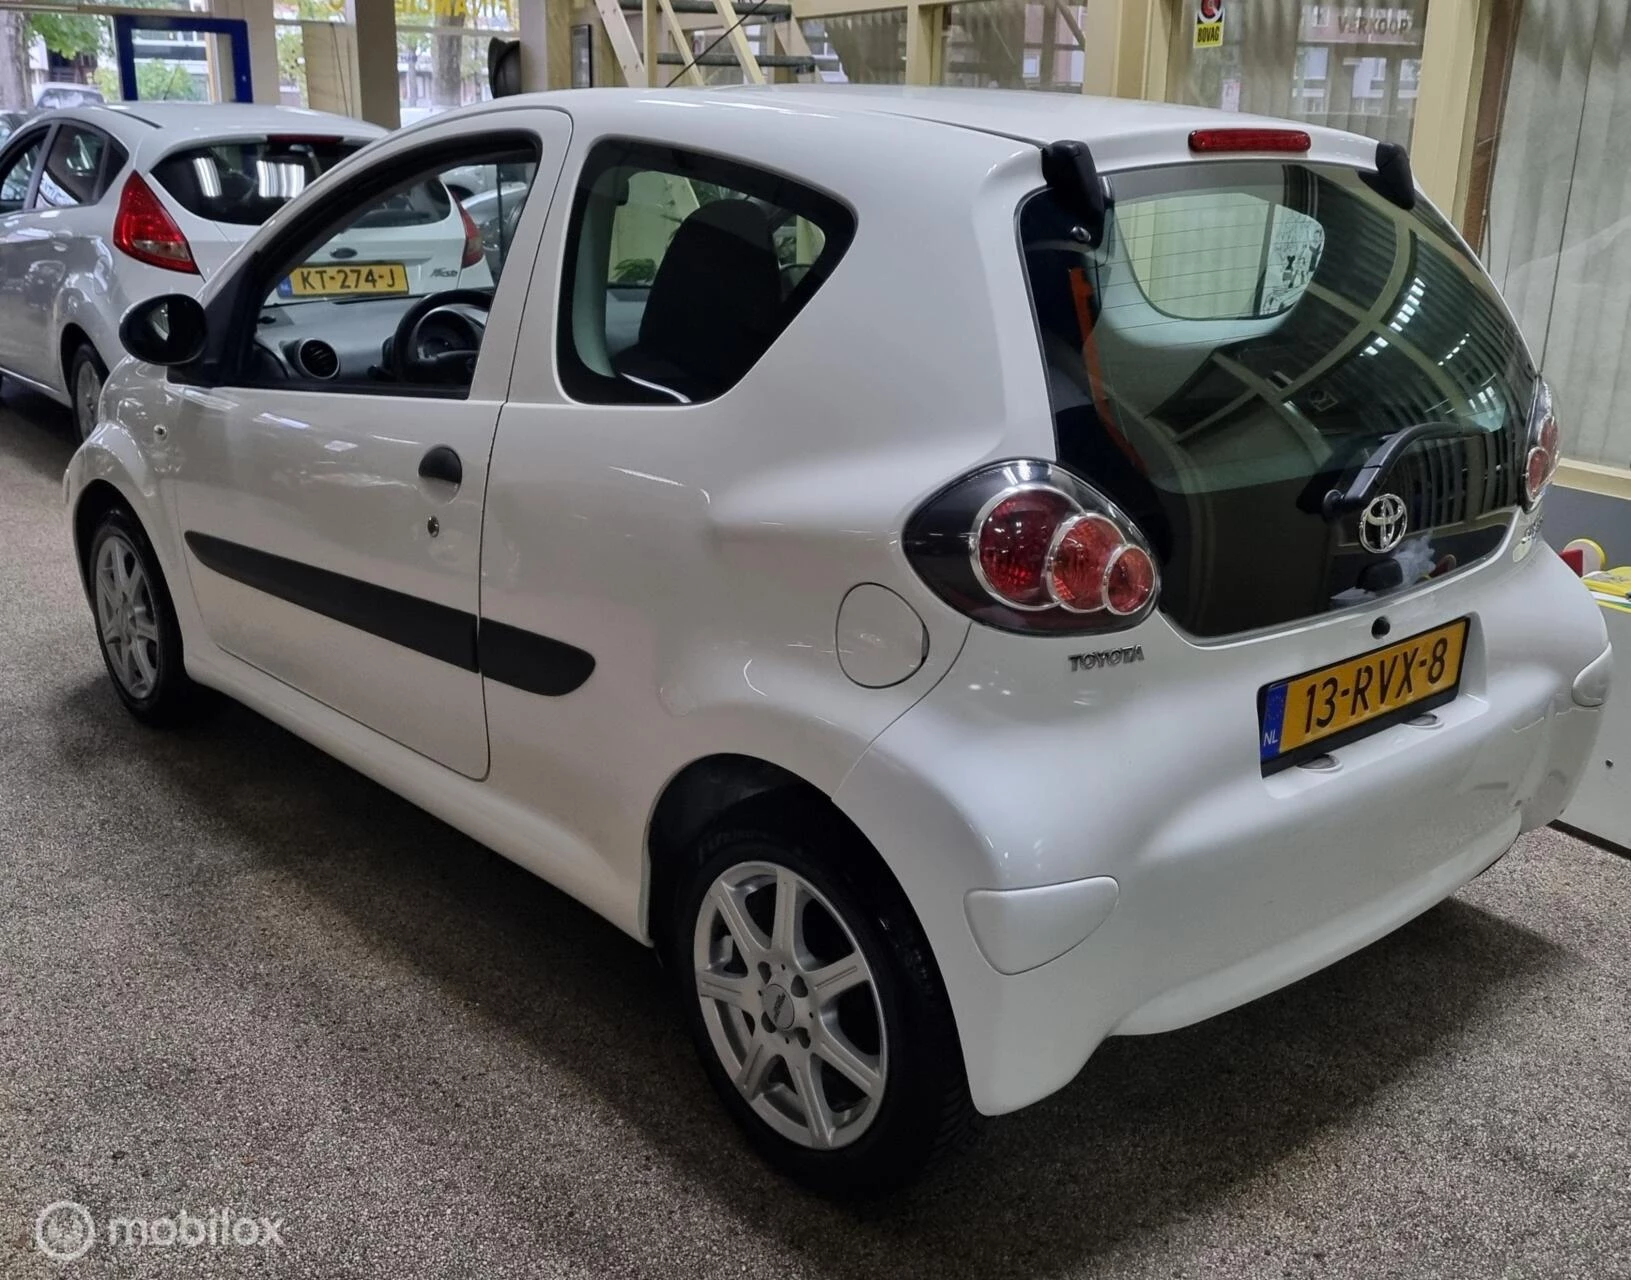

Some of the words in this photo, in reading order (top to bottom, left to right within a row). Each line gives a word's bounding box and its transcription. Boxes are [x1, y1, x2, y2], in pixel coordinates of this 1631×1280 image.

[1197, 25, 1220, 43] BOVAG
[300, 268, 395, 291] KT-274-J
[1067, 644, 1145, 672] TOYOTA
[1304, 636, 1449, 735] 13-RVX-8
[1263, 728, 1279, 748] NL
